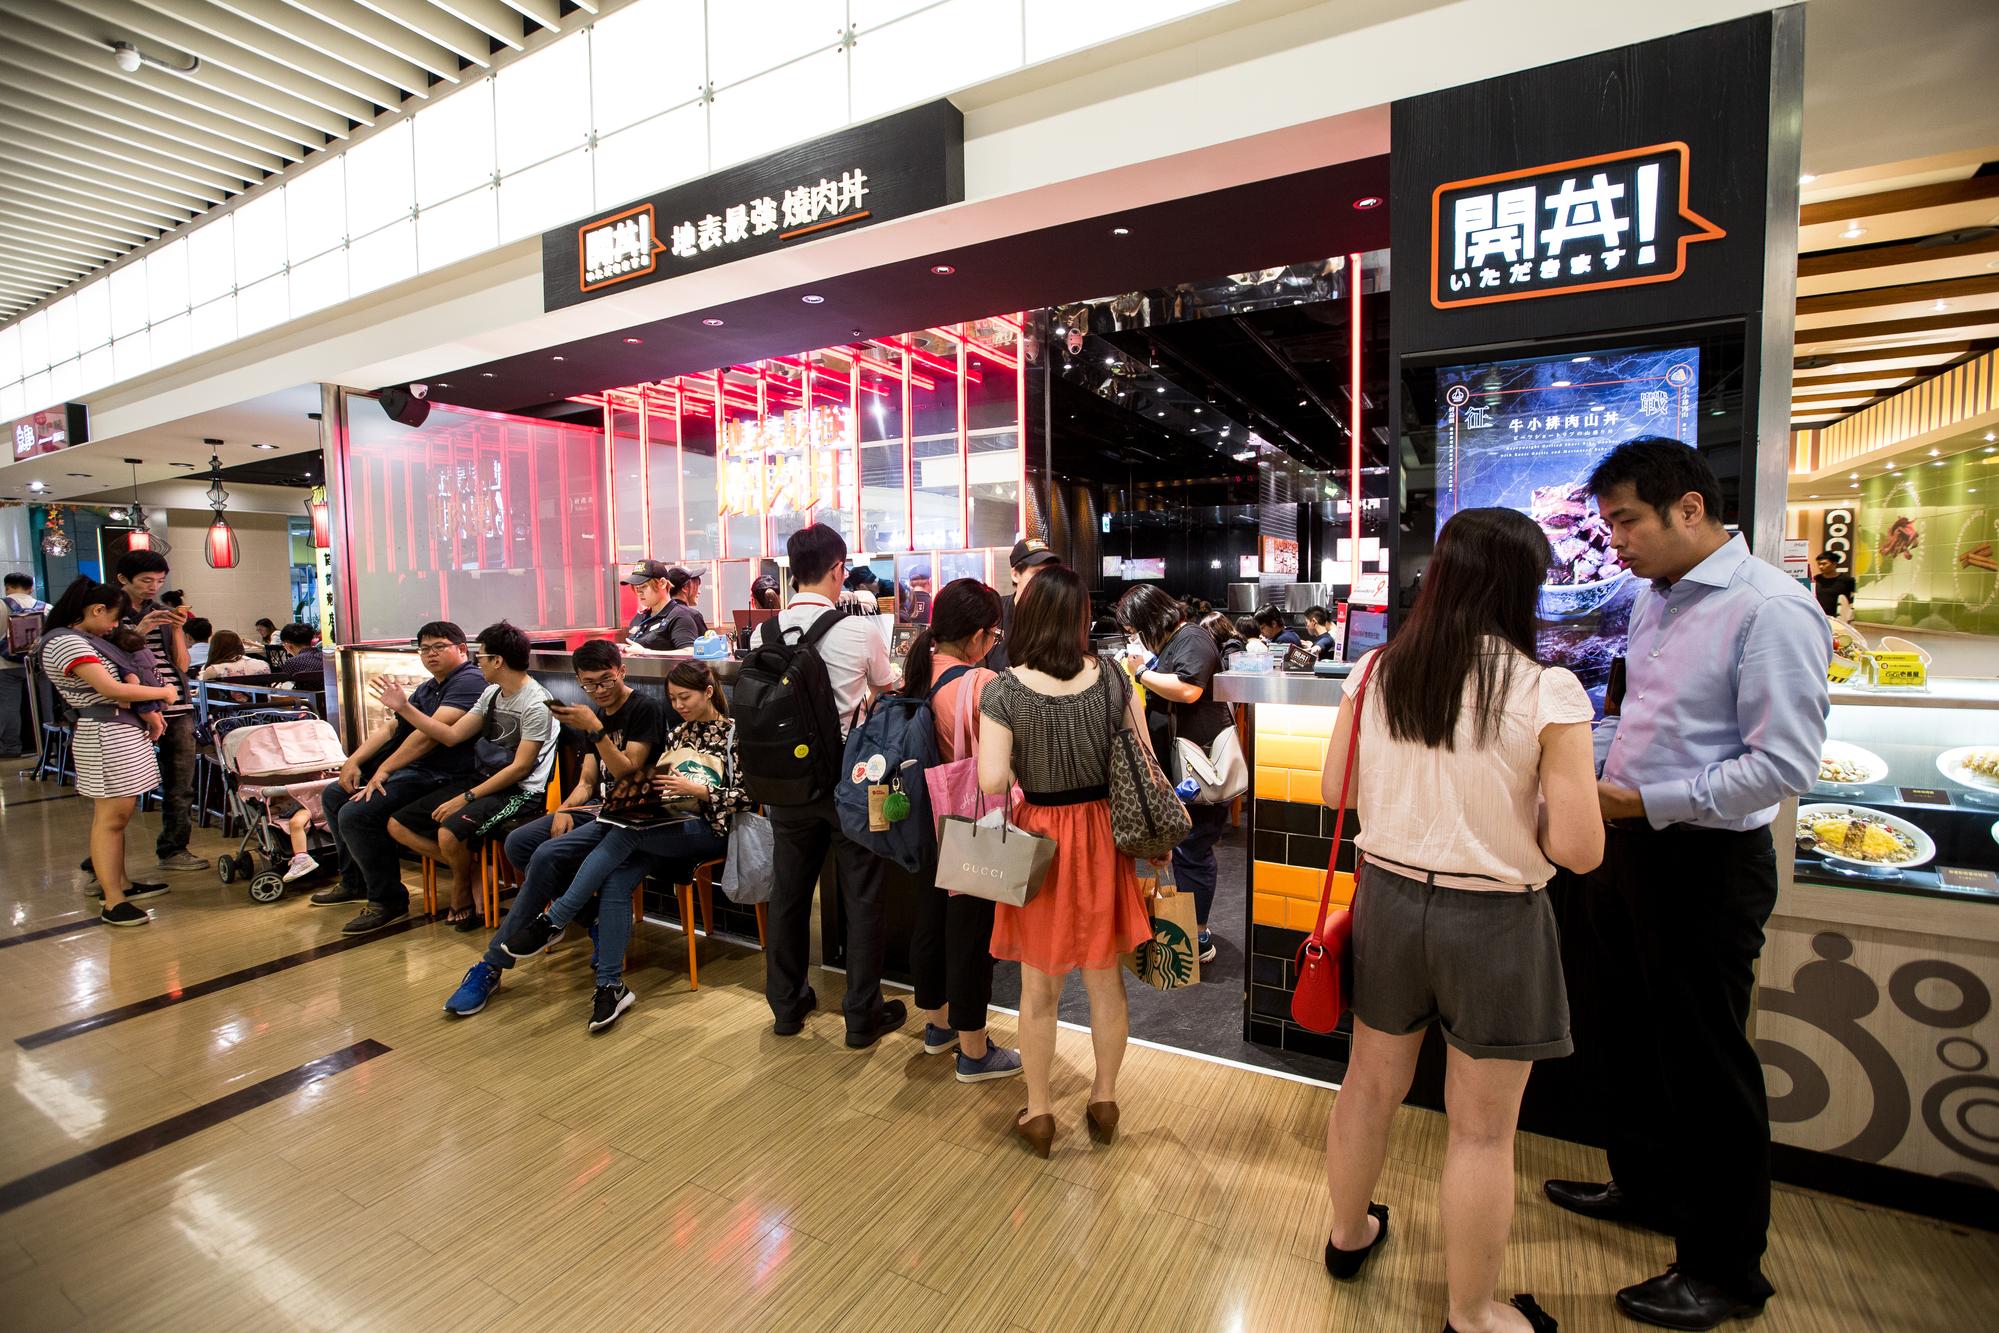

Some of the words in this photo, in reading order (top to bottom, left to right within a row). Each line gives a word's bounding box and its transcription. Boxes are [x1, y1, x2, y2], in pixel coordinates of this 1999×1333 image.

[671, 197, 778, 257] 地表最強
[781, 168, 870, 228] 燒肉丼
[1453, 163, 1660, 270] 開丼!
[1450, 248, 1626, 291] いただきます
[1508, 411, 1619, 433] 牛小排肉山丼
[962, 862, 1003, 880] GUCCI
